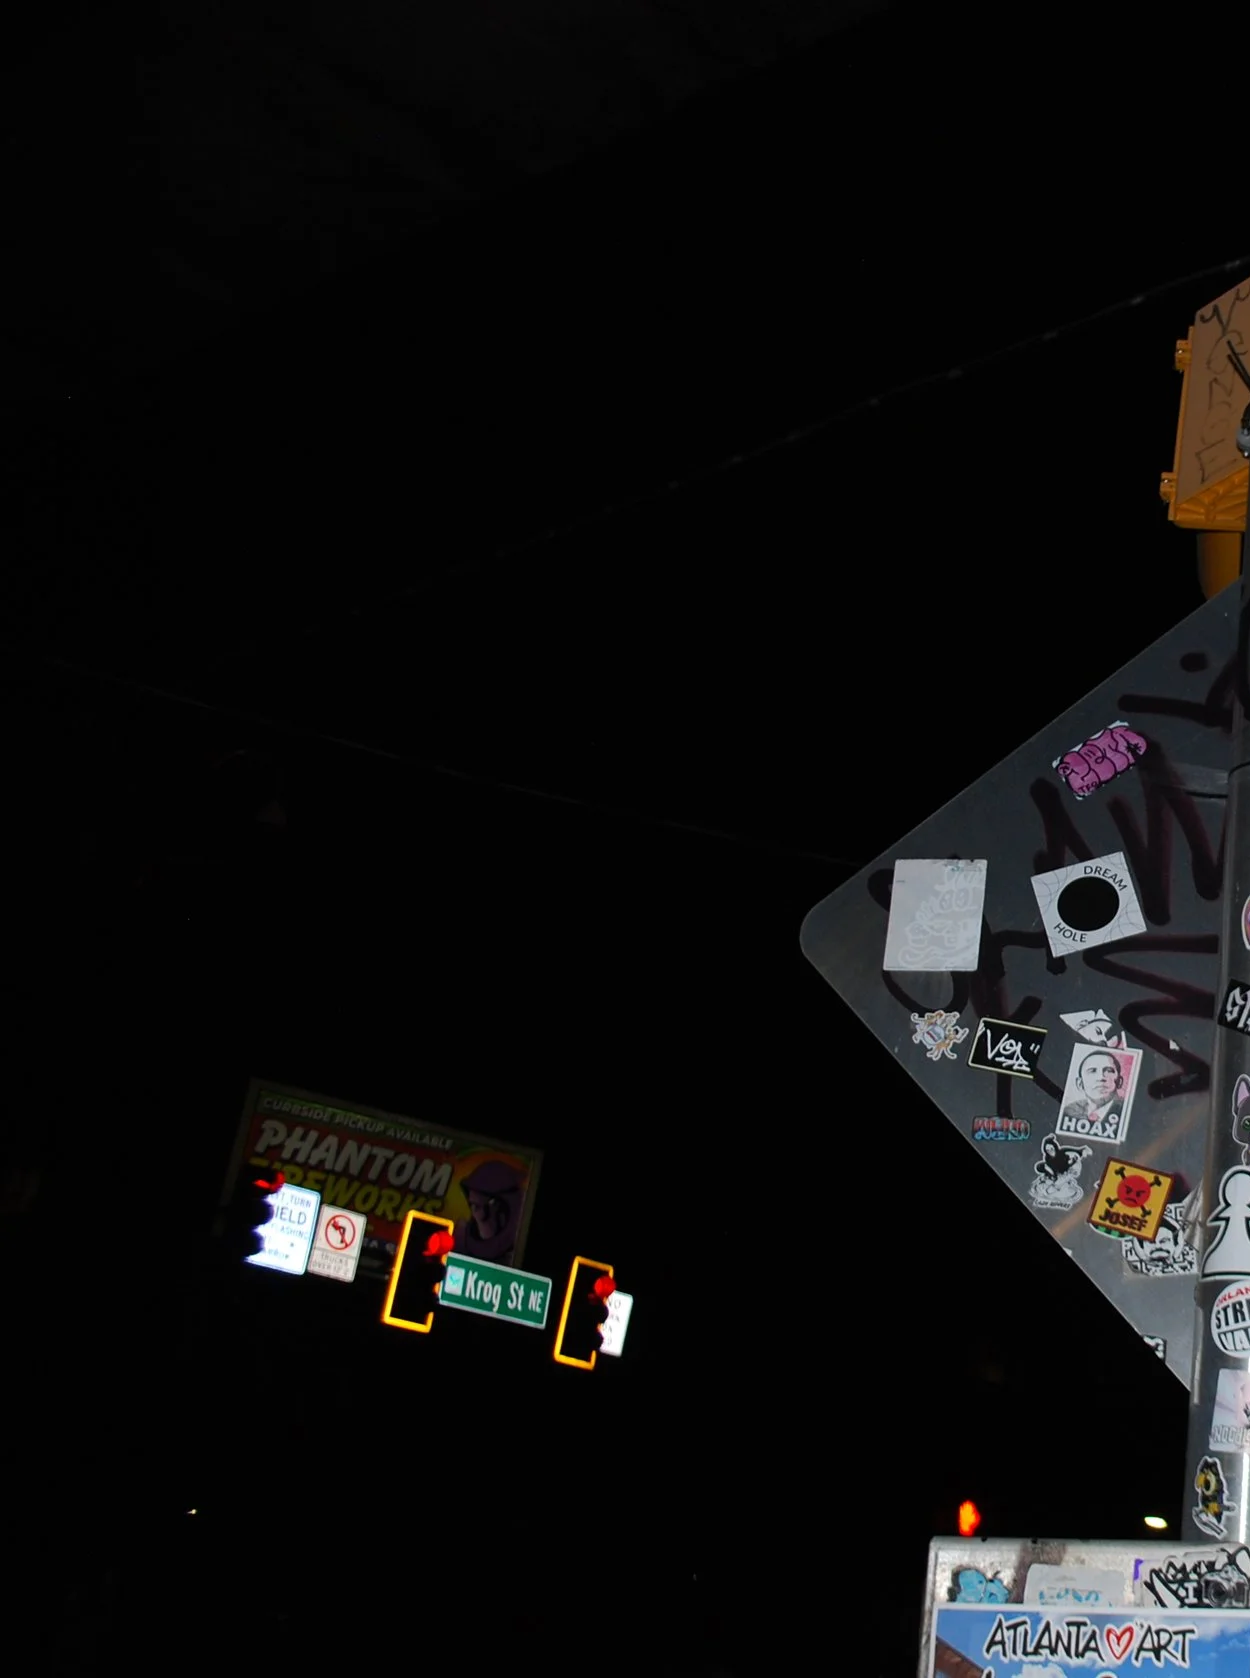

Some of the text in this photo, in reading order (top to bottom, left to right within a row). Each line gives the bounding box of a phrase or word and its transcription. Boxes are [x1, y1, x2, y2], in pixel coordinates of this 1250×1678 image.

[1083, 865, 1127, 892] DREAM
[1053, 922, 1088, 944] HOLE
[263, 1097, 454, 1151] CURBSIDE PICKUP AVAILABLE
[1062, 1115, 1117, 1139] HOAX
[254, 1118, 454, 1196] PHANTOM
[274, 1204, 307, 1226] IELD
[1098, 1208, 1148, 1231] JOSEF
[465, 1270, 544, 1313] Krog St NE
[985, 1618, 1196, 1664] ATLANTA ART
